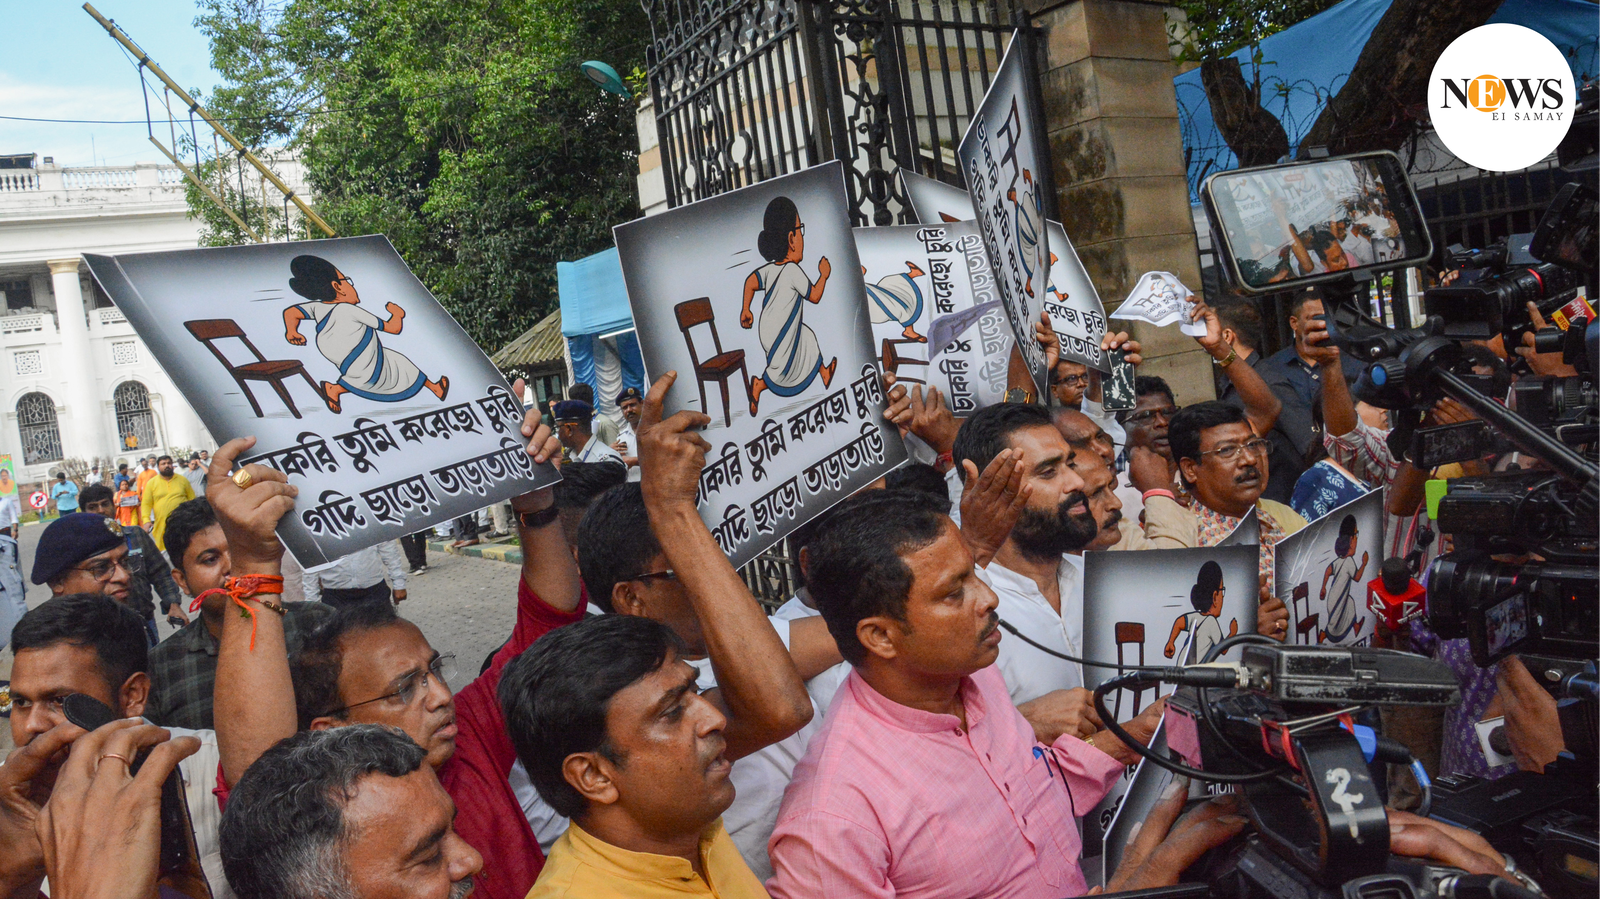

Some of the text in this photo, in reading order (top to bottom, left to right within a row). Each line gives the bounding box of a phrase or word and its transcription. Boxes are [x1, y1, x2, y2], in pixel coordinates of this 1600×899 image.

[916, 227, 954, 255] চুরি
[928, 257, 955, 314] করেছো
[1044, 301, 1104, 336] রেছো চুরি
[939, 359, 976, 413] চাকরি
[239, 385, 523, 479] াকরি তুমি করেছো চুরি
[694, 363, 884, 509] াকরি তুমি করেছো চুরি
[301, 437, 534, 539] গদি ছাড়ো তাড়াতাড়ি
[750, 475, 803, 535] ছাড়ো
[802, 421, 886, 495] তাড়াতাড়ি
